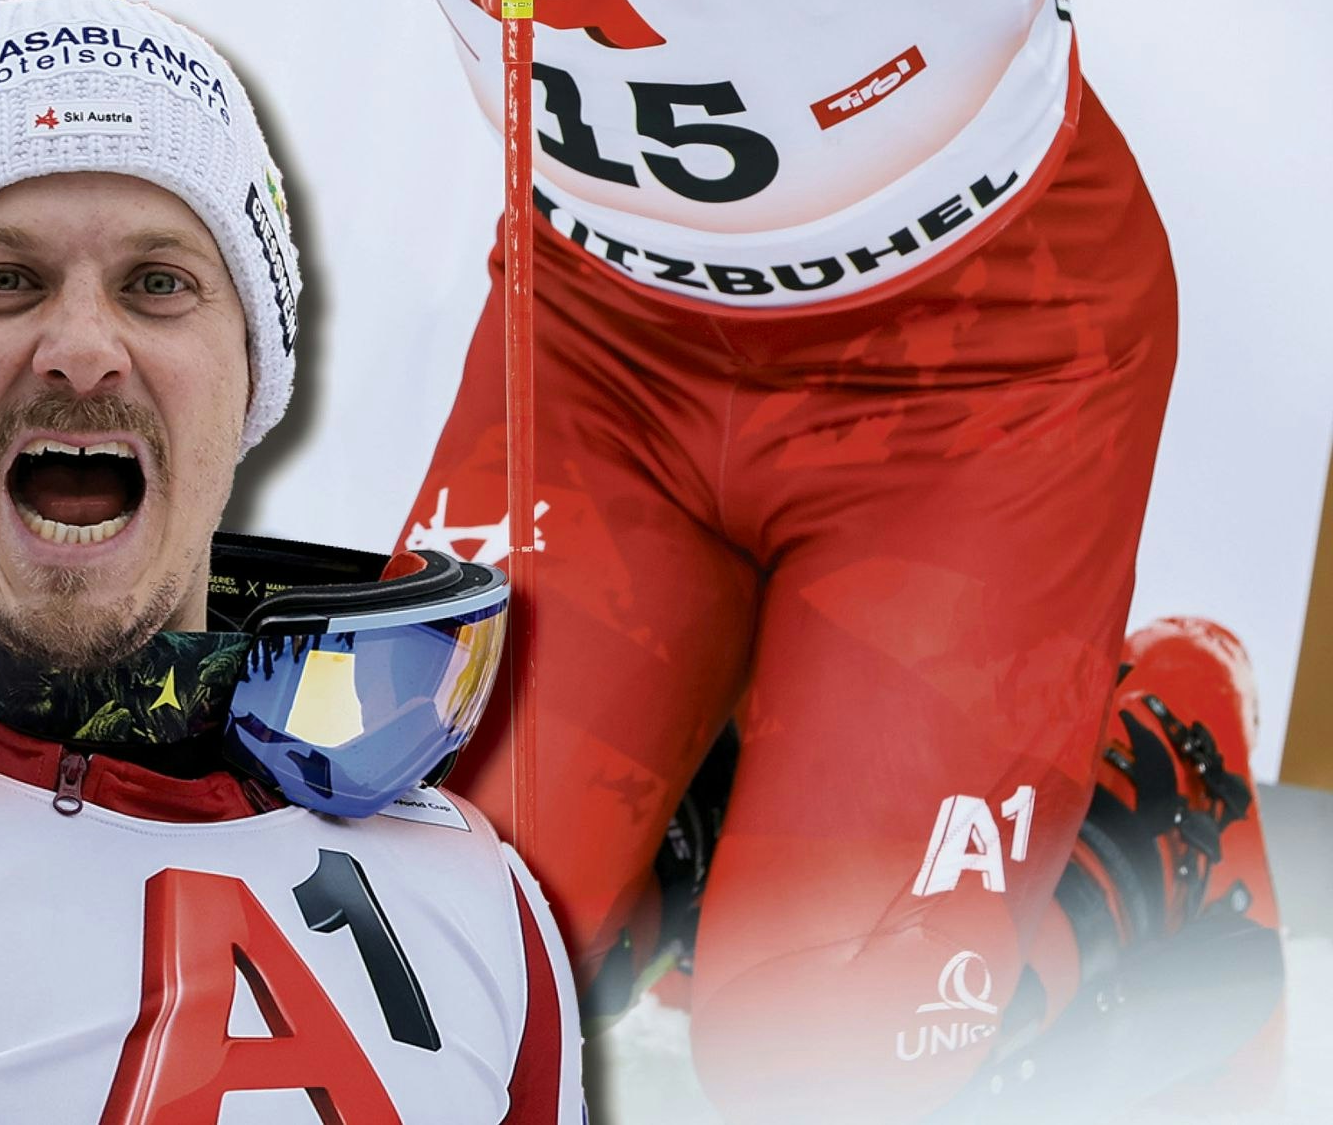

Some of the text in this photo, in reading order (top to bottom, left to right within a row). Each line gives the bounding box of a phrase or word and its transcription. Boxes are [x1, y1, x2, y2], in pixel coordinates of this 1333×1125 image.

[64, 111, 133, 123] Ski Austria
[827, 58, 912, 112] Tirol
[533, 62, 780, 203] 15
[911, 785, 1036, 897] A1
[96, 846, 443, 1125] A1
[896, 1022, 997, 1062] UNI
